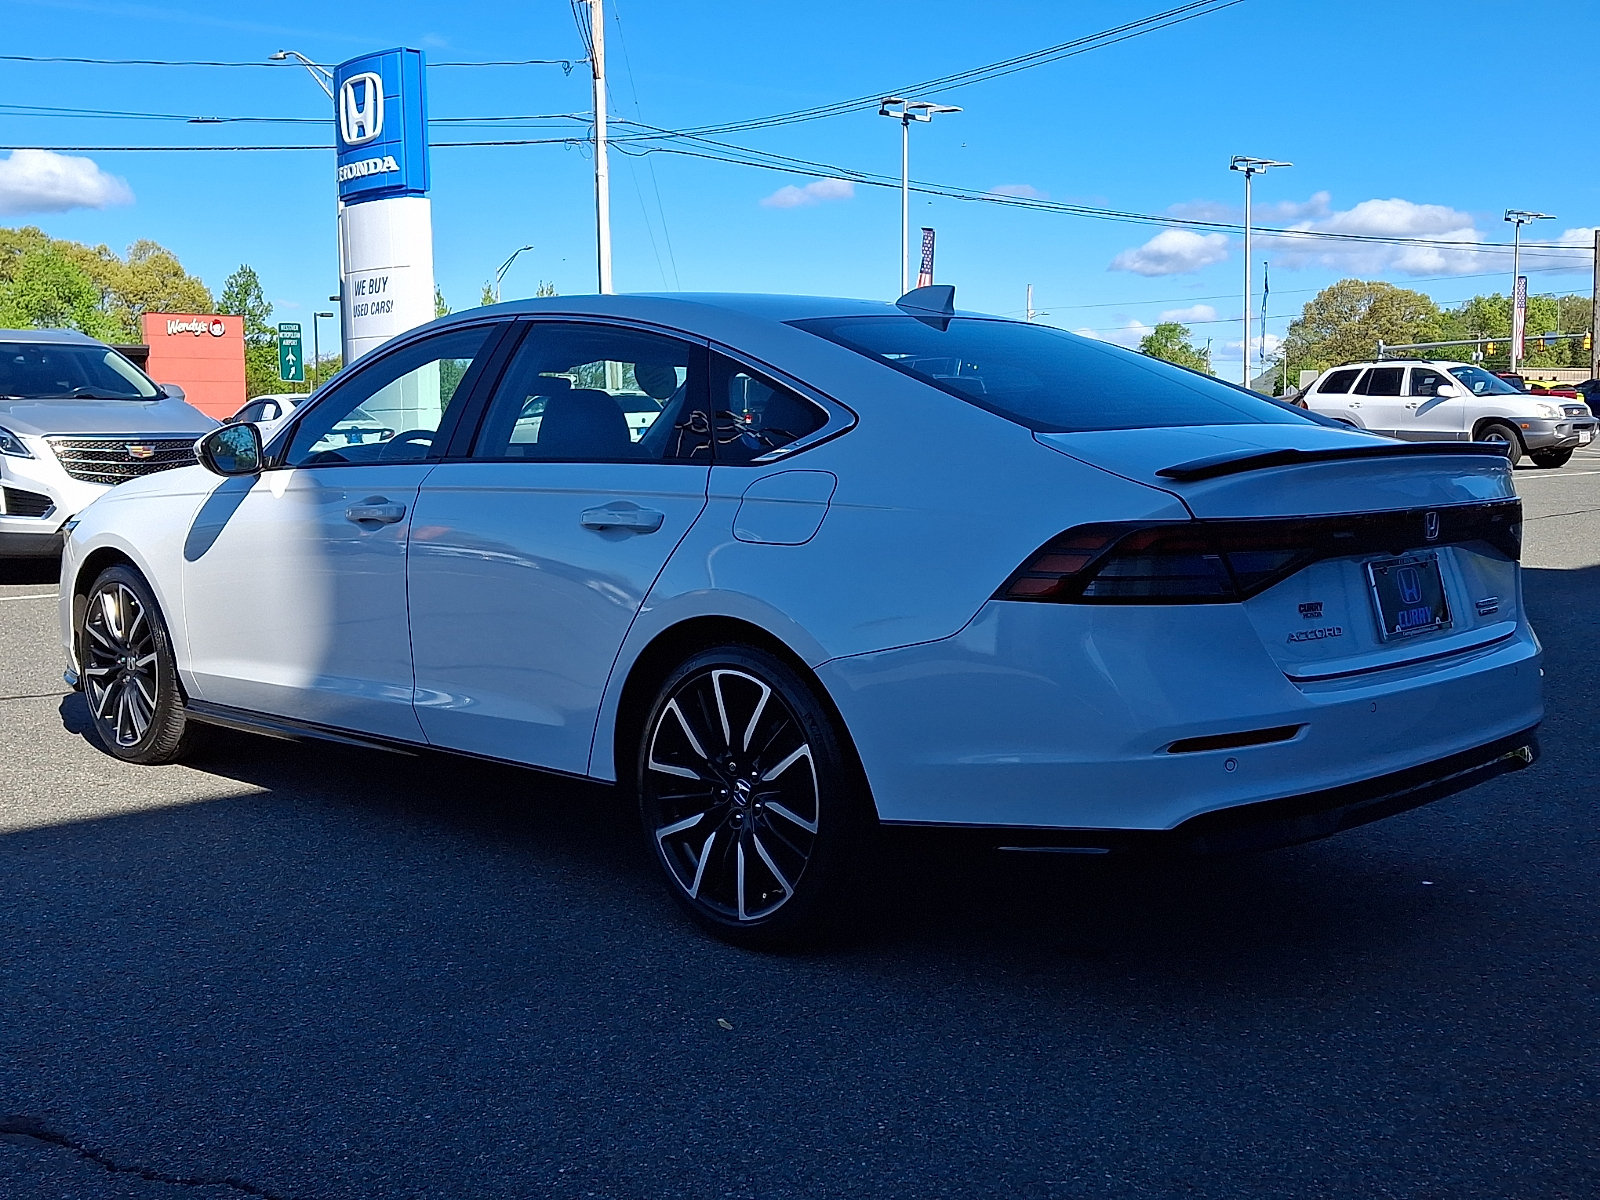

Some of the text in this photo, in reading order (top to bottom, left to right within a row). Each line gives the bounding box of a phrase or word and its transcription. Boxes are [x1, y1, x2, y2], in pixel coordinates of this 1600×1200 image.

[338, 155, 400, 182] HONDA
[354, 275, 389, 297] WE BUY
[353, 299, 394, 318] USED CARS!
[166, 319, 208, 336] Wendy's
[1298, 601, 1324, 614] CURRY
[1398, 606, 1432, 628] CURRY
[1286, 626, 1344, 644] ACCORD
